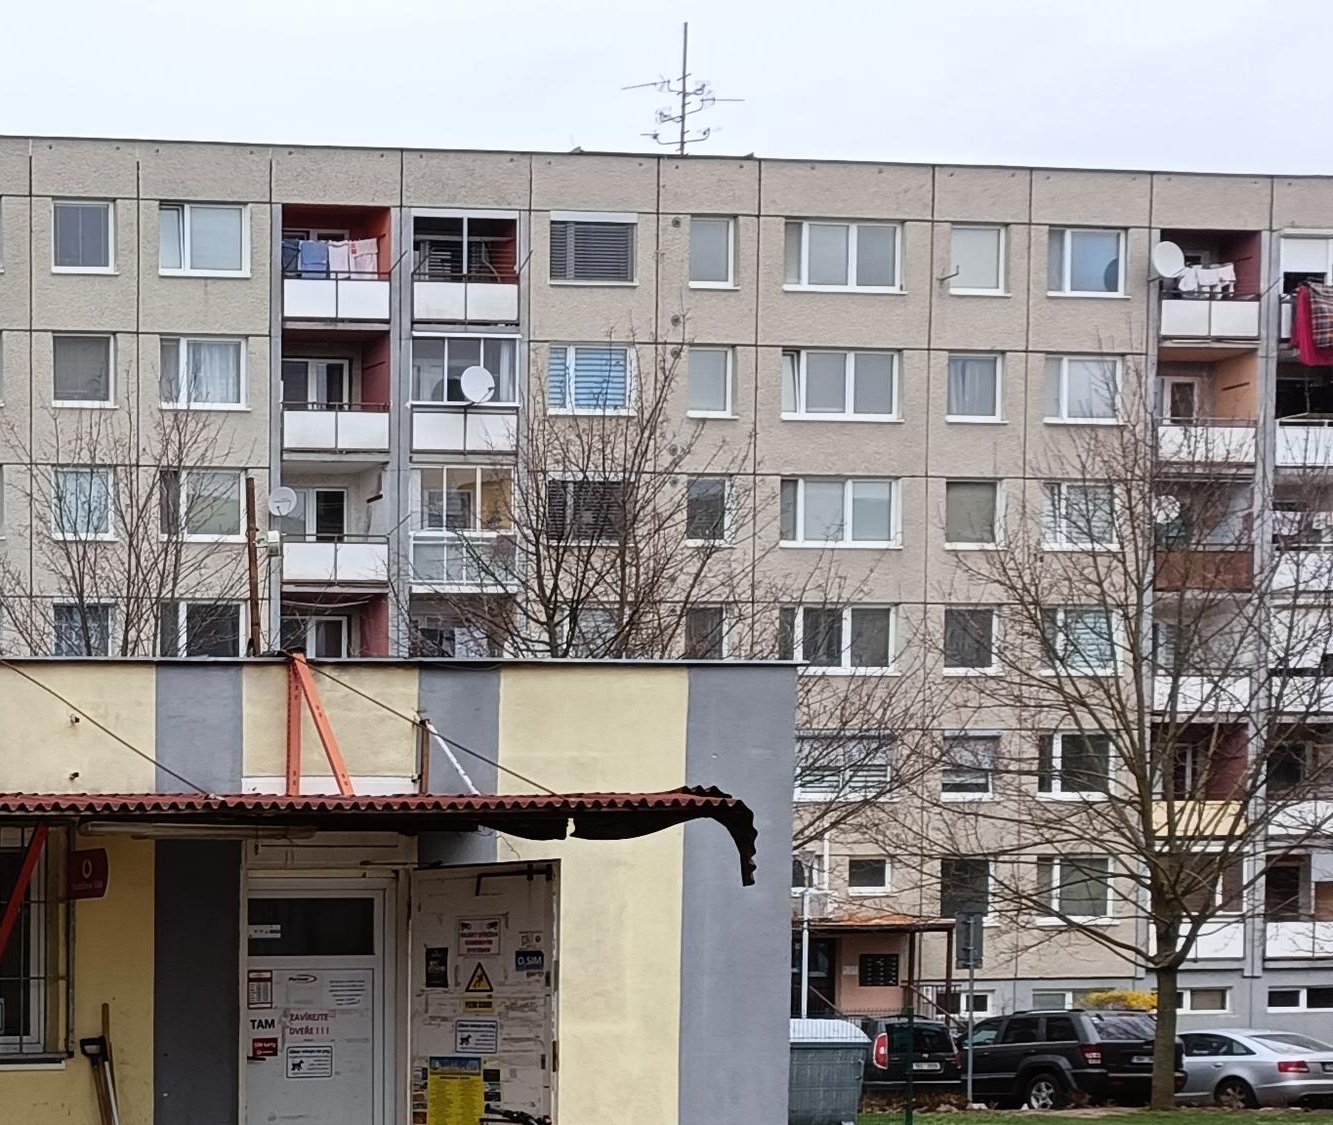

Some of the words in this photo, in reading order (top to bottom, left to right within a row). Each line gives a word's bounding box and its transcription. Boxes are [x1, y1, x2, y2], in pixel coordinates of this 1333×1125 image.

[289, 1011, 328, 1022] ZAVÍREJTE
[250, 1018, 276, 1030] TAM
[289, 1025, 314, 1036] DVEŘE
